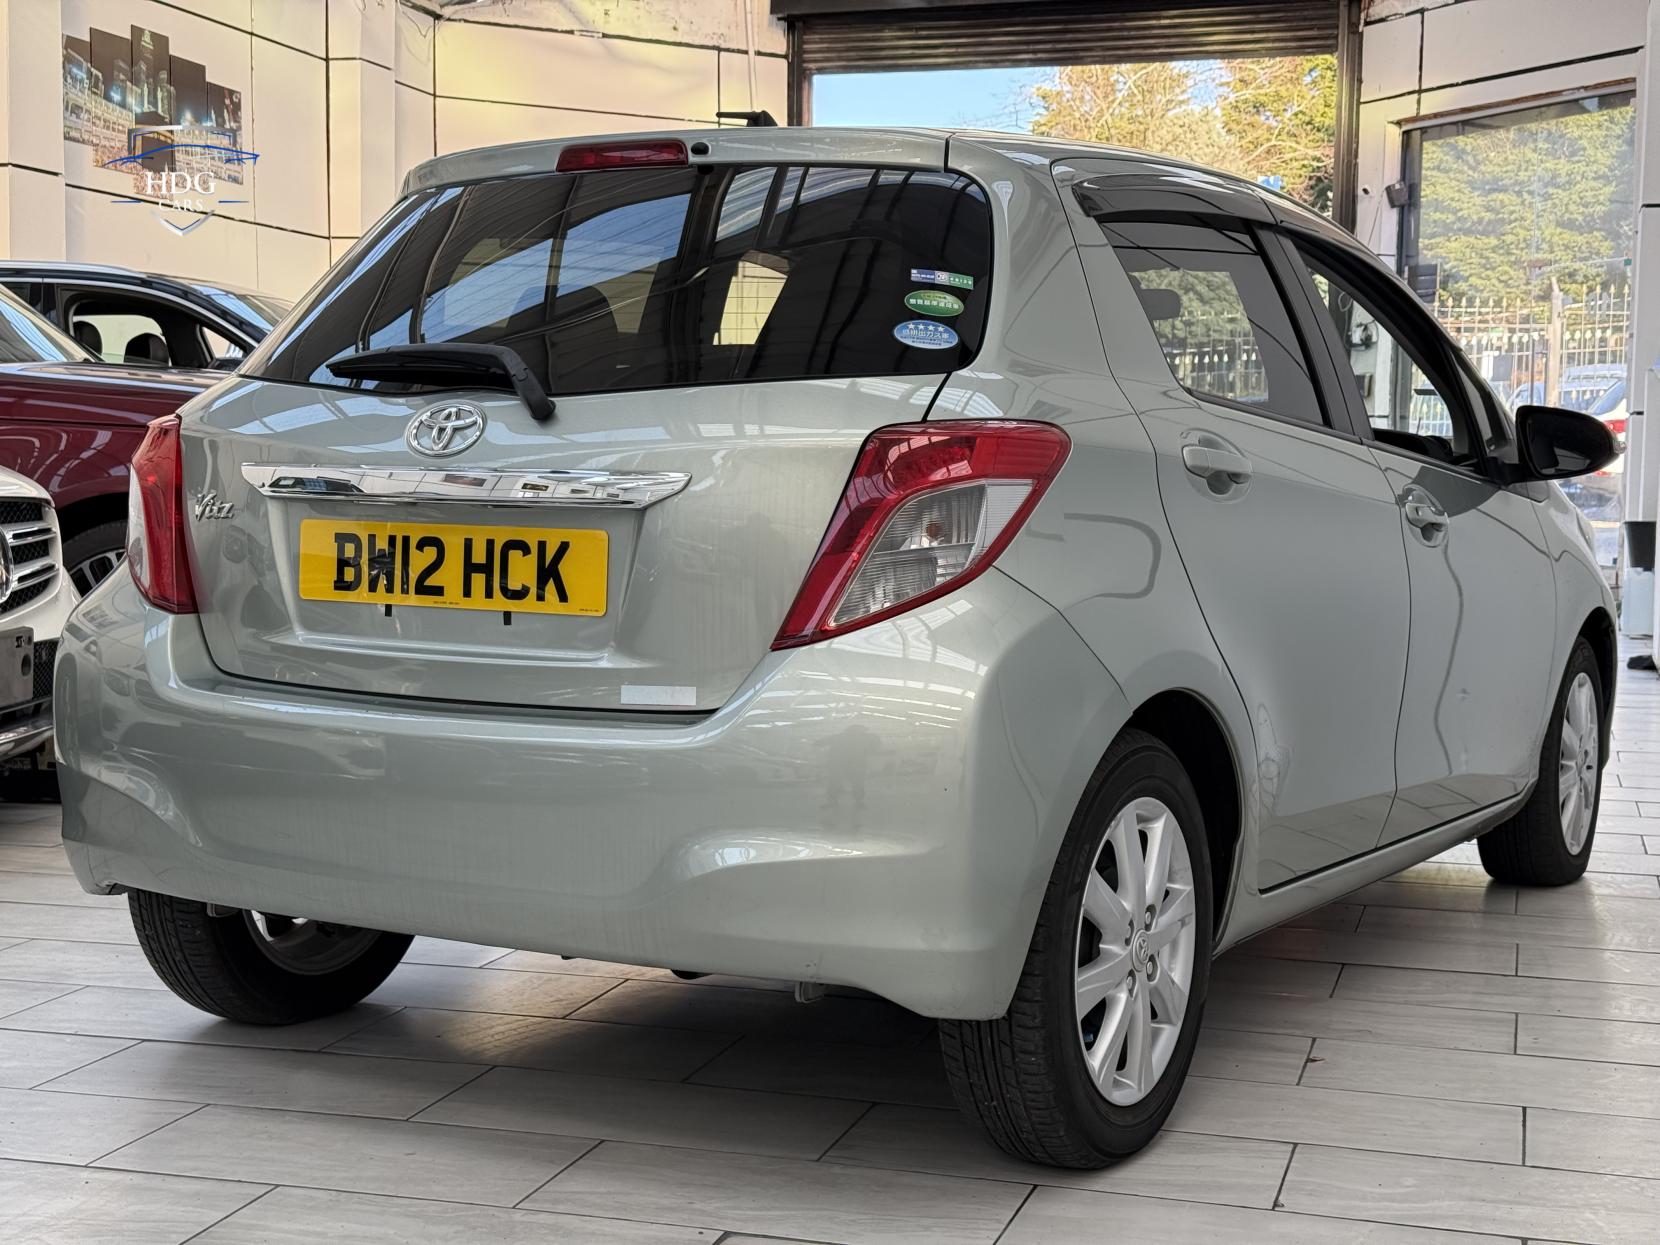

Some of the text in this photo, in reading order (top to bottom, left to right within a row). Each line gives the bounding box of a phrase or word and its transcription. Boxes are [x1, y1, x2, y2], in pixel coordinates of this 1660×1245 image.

[194, 491, 234, 521] Vitz
[333, 532, 571, 603] BW12 HCK
